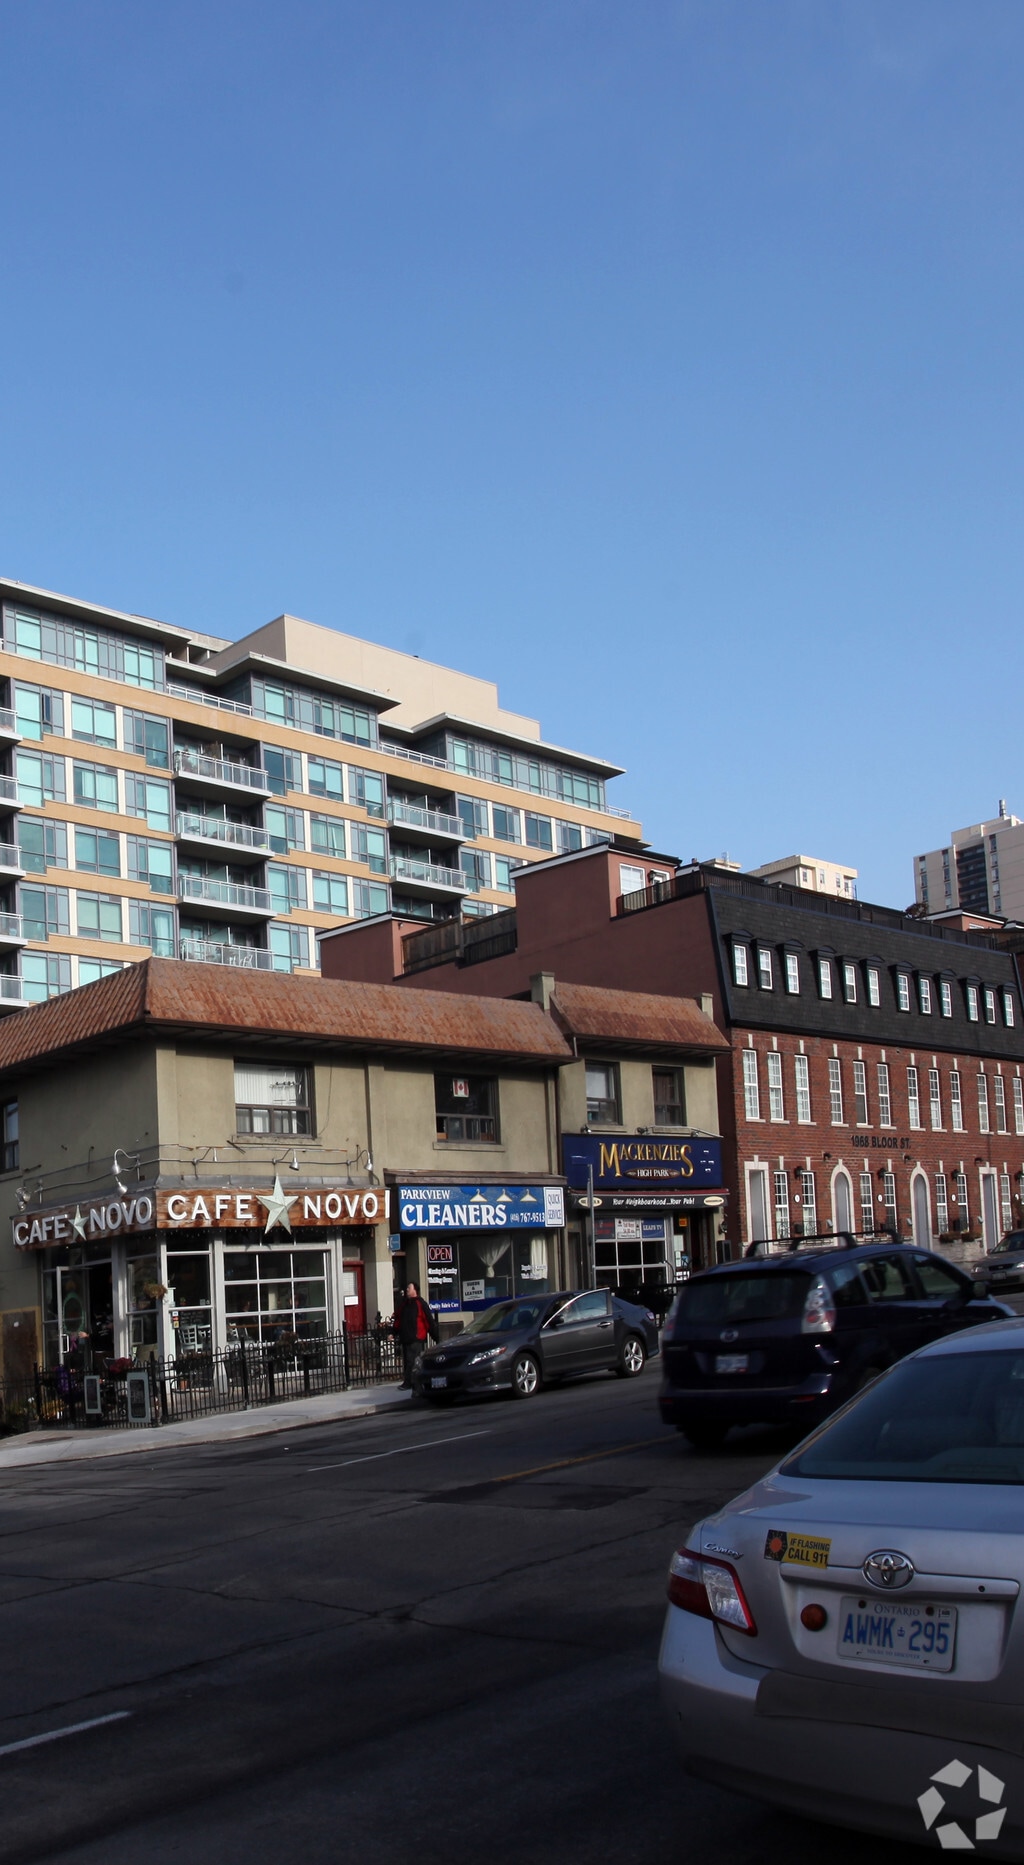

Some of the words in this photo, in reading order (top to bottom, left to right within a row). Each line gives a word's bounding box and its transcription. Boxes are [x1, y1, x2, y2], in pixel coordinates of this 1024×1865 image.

[851, 1135, 869, 1148] 1968
[871, 1136, 898, 1149] BLOOR
[900, 1137, 911, 1149] ST.
[637, 1168, 653, 1177] HIGH
[653, 1168, 670, 1177] PARK
[400, 1189, 451, 1200] PARKVIEW
[167, 1194, 253, 1220] CAFE
[303, 1192, 379, 1219] NOVO
[14, 1213, 69, 1246] CAFE
[90, 1196, 152, 1233] NOVO
[401, 1204, 507, 1227] CLEANERS
[429, 1247, 451, 1262] OPEN
[797, 1539, 830, 1551] FLASHING
[788, 1547, 810, 1562] CALL
[813, 1551, 828, 1565] 911
[874, 1602, 921, 1617] ONTARIO
[843, 1613, 896, 1649] AWMK
[908, 1620, 950, 1654] 295
